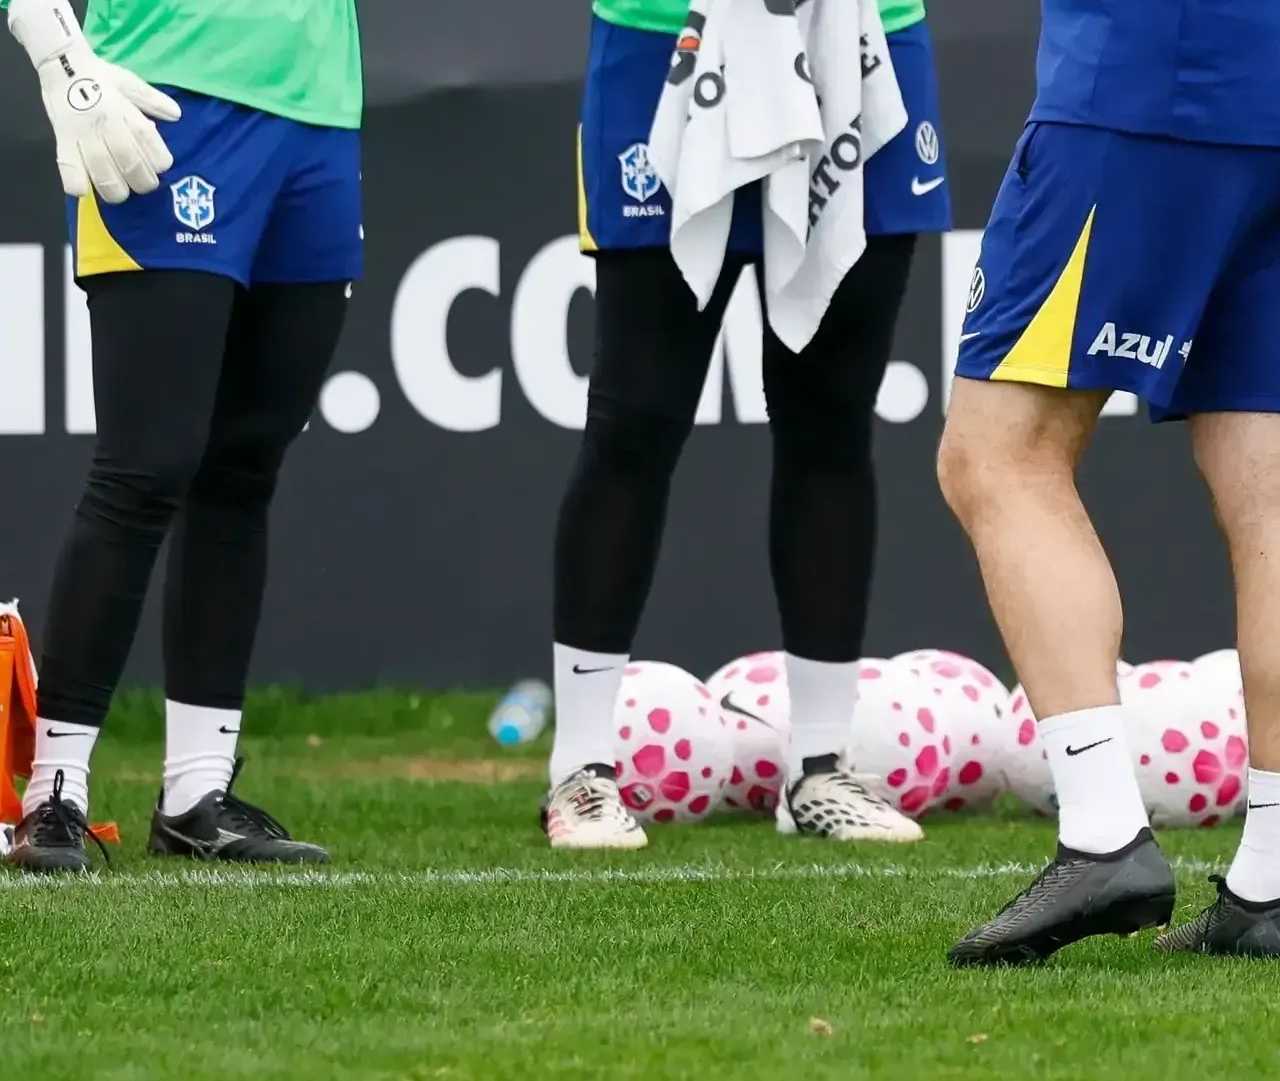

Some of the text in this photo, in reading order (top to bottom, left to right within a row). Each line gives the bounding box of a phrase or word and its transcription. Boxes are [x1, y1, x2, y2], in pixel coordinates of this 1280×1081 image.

[622, 205, 664, 217] BRASIL
[175, 232, 216, 244] BRASIL
[1087, 322, 1173, 369] Azul
